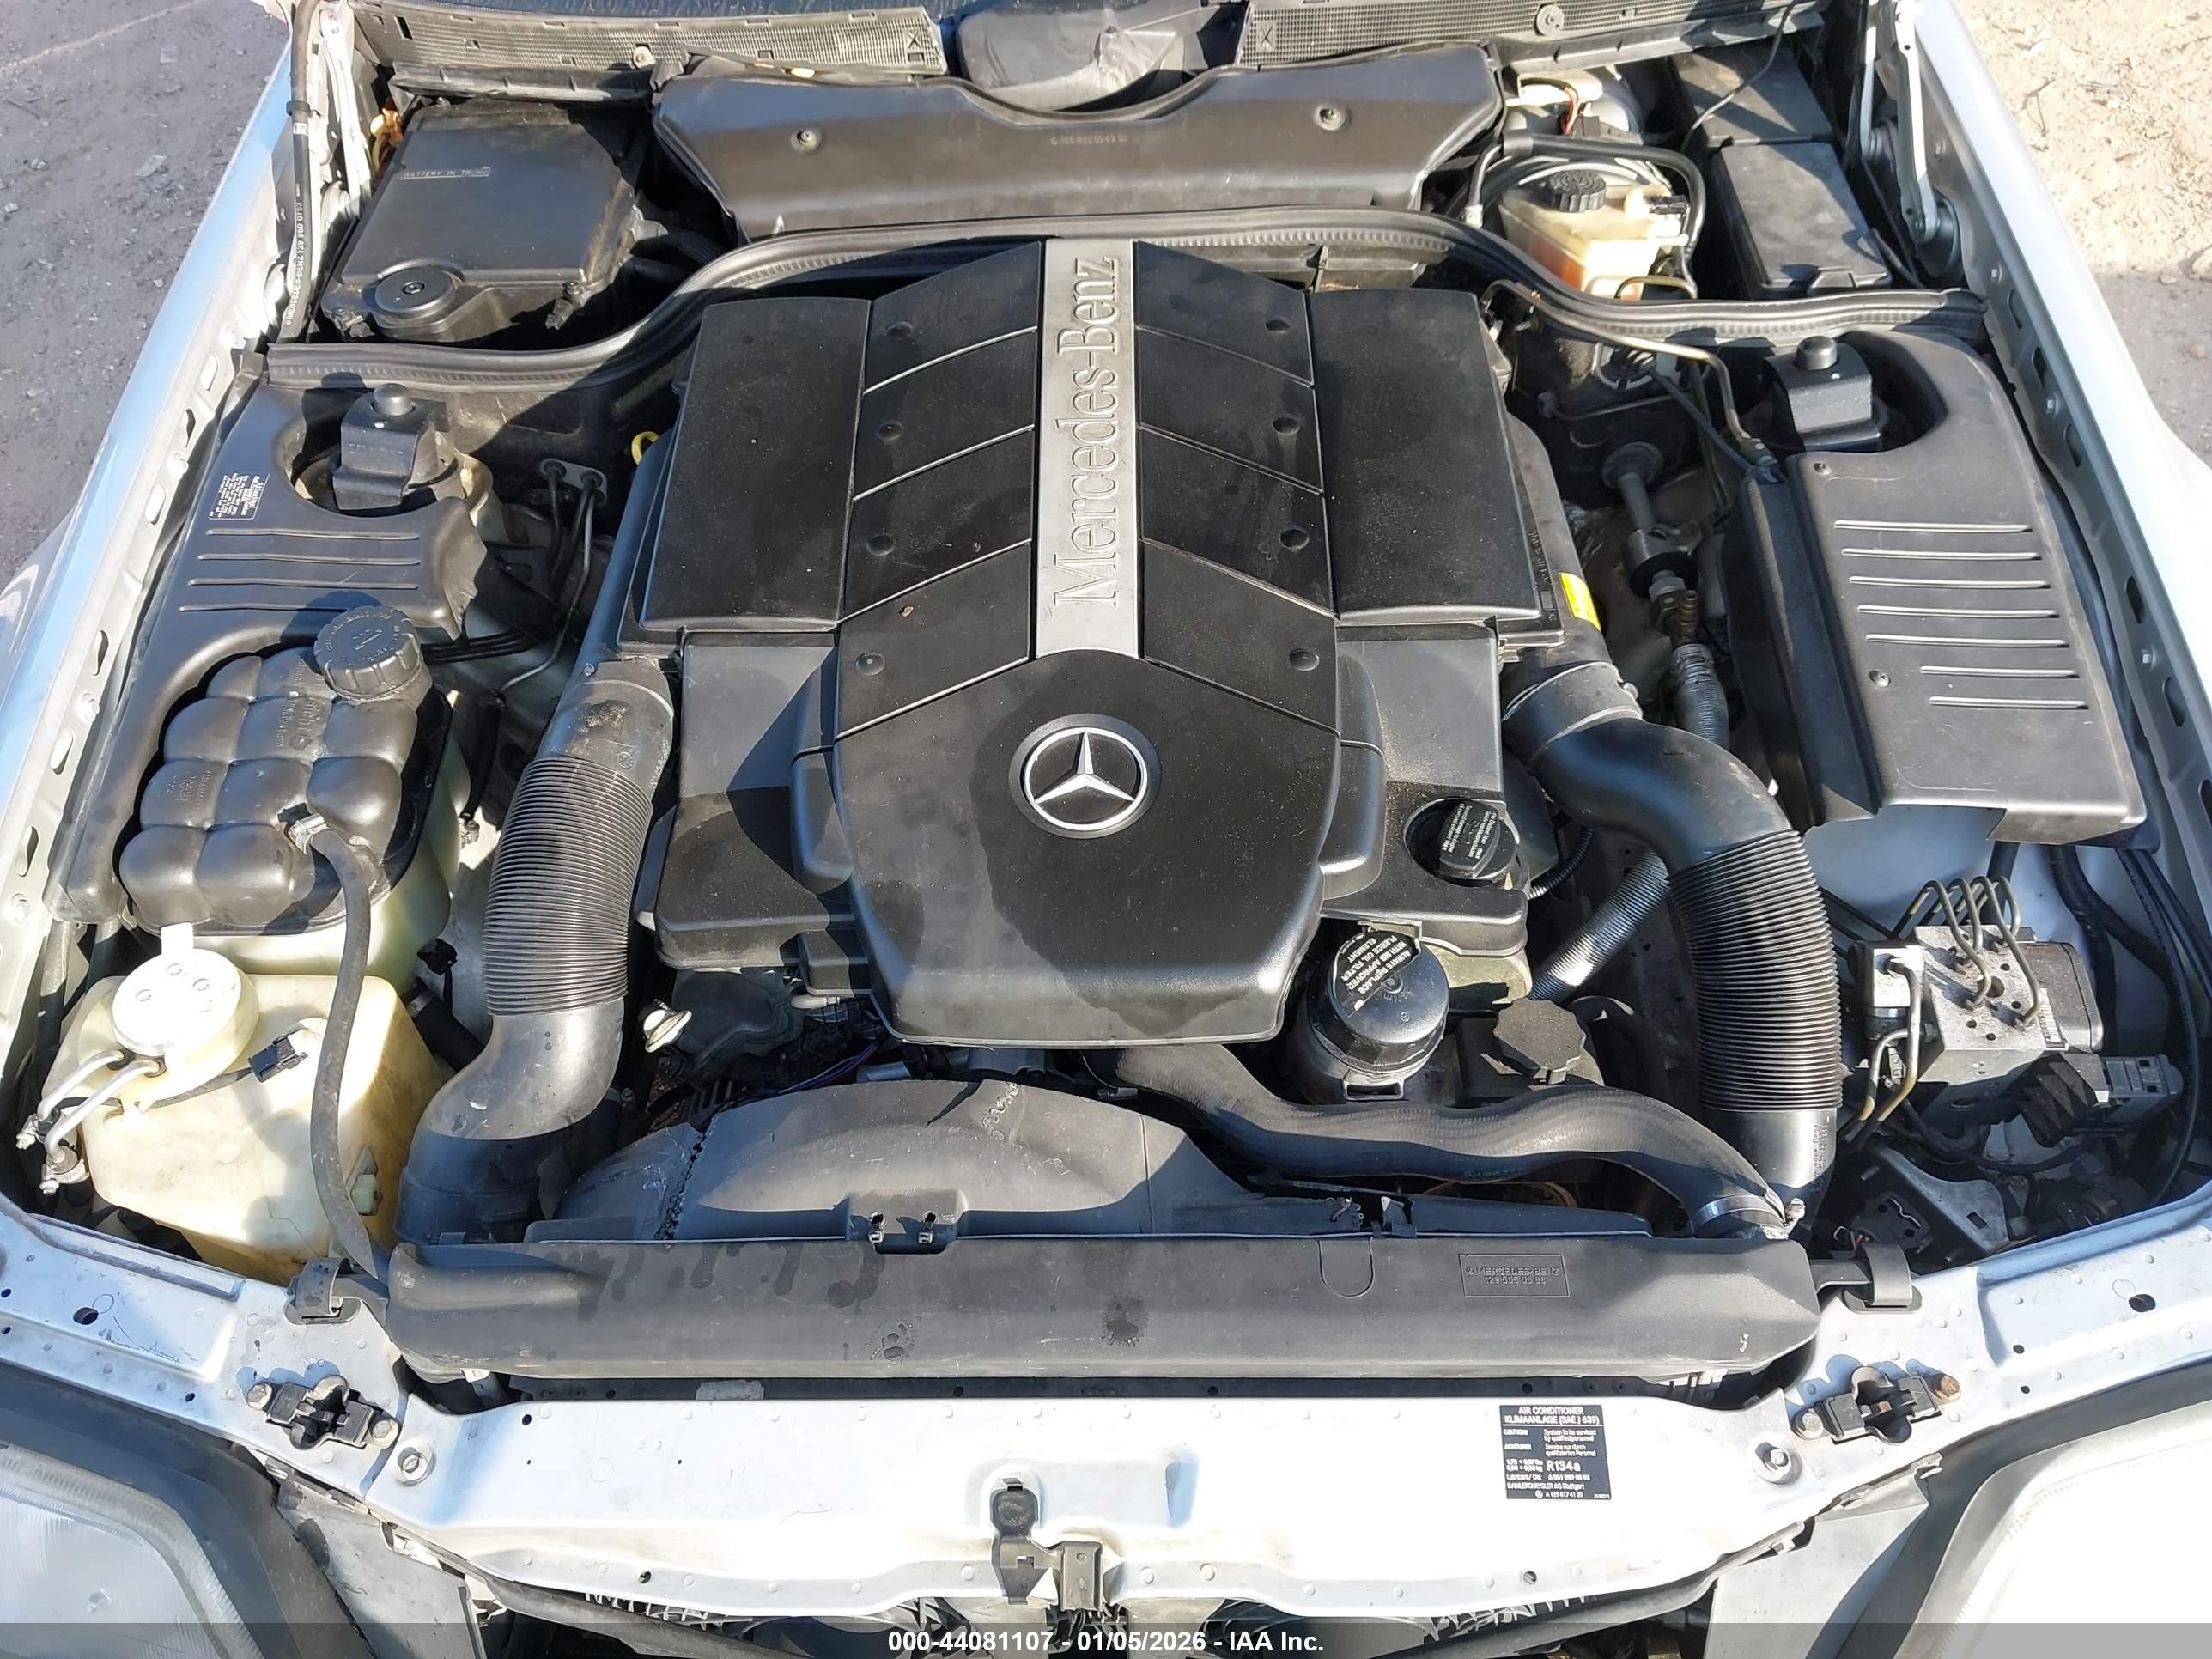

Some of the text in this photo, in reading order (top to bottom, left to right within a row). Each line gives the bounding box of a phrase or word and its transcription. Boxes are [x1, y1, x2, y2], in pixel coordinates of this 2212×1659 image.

[1054, 257, 1118, 607] Mercedes-Benz
[1347, 938, 1377, 963] ELEMENT
[1371, 935, 1398, 955] FLEECE
[1389, 940, 1407, 955] WITH
[1360, 951, 1375, 963] OIL
[1340, 961, 1364, 981] FILTER
[1345, 961, 1381, 990] APPROVED
[1358, 950, 1411, 994] ALWAYS REPLACE
[1518, 1406, 1585, 1415] AIR CONDITIONER
[1504, 1415, 1559, 1425] KLIMAANLAGE
[1559, 1415, 1577, 1425] (SAE
[1582, 1415, 1600, 1425] 639)
[1543, 1428, 1563, 1437] System
[1545, 1459, 1582, 1472] R134a
[1562, 1482, 1585, 1492] Stuttgart
